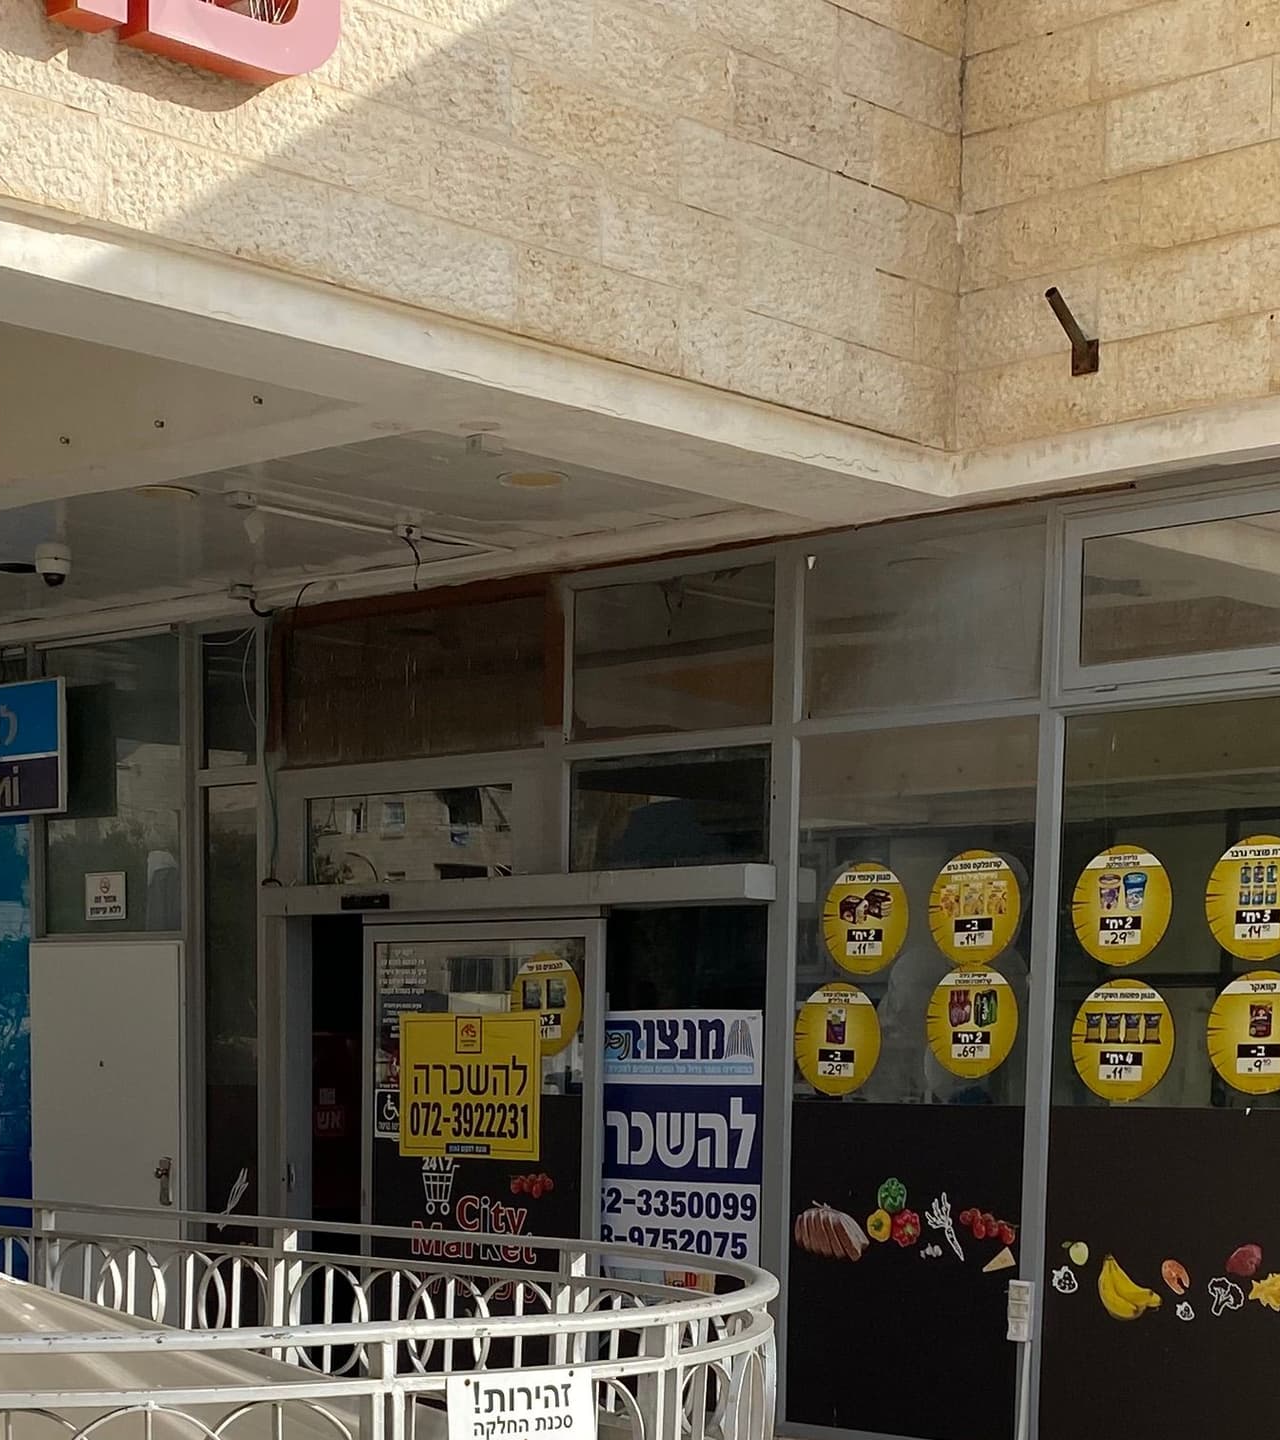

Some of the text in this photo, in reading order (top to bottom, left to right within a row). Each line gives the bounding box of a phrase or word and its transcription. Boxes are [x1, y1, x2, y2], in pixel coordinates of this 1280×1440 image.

[413, 1055, 529, 1096] להשכרה
[317, 1110, 342, 1130] אש
[410, 1102, 529, 1139] 072-3922231
[456, 1194, 528, 1236] City
[601, 1187, 757, 1219] 2-3350099
[473, 1381, 572, 1414] זהירות!
[473, 1415, 573, 1440] סכנת החלקה
